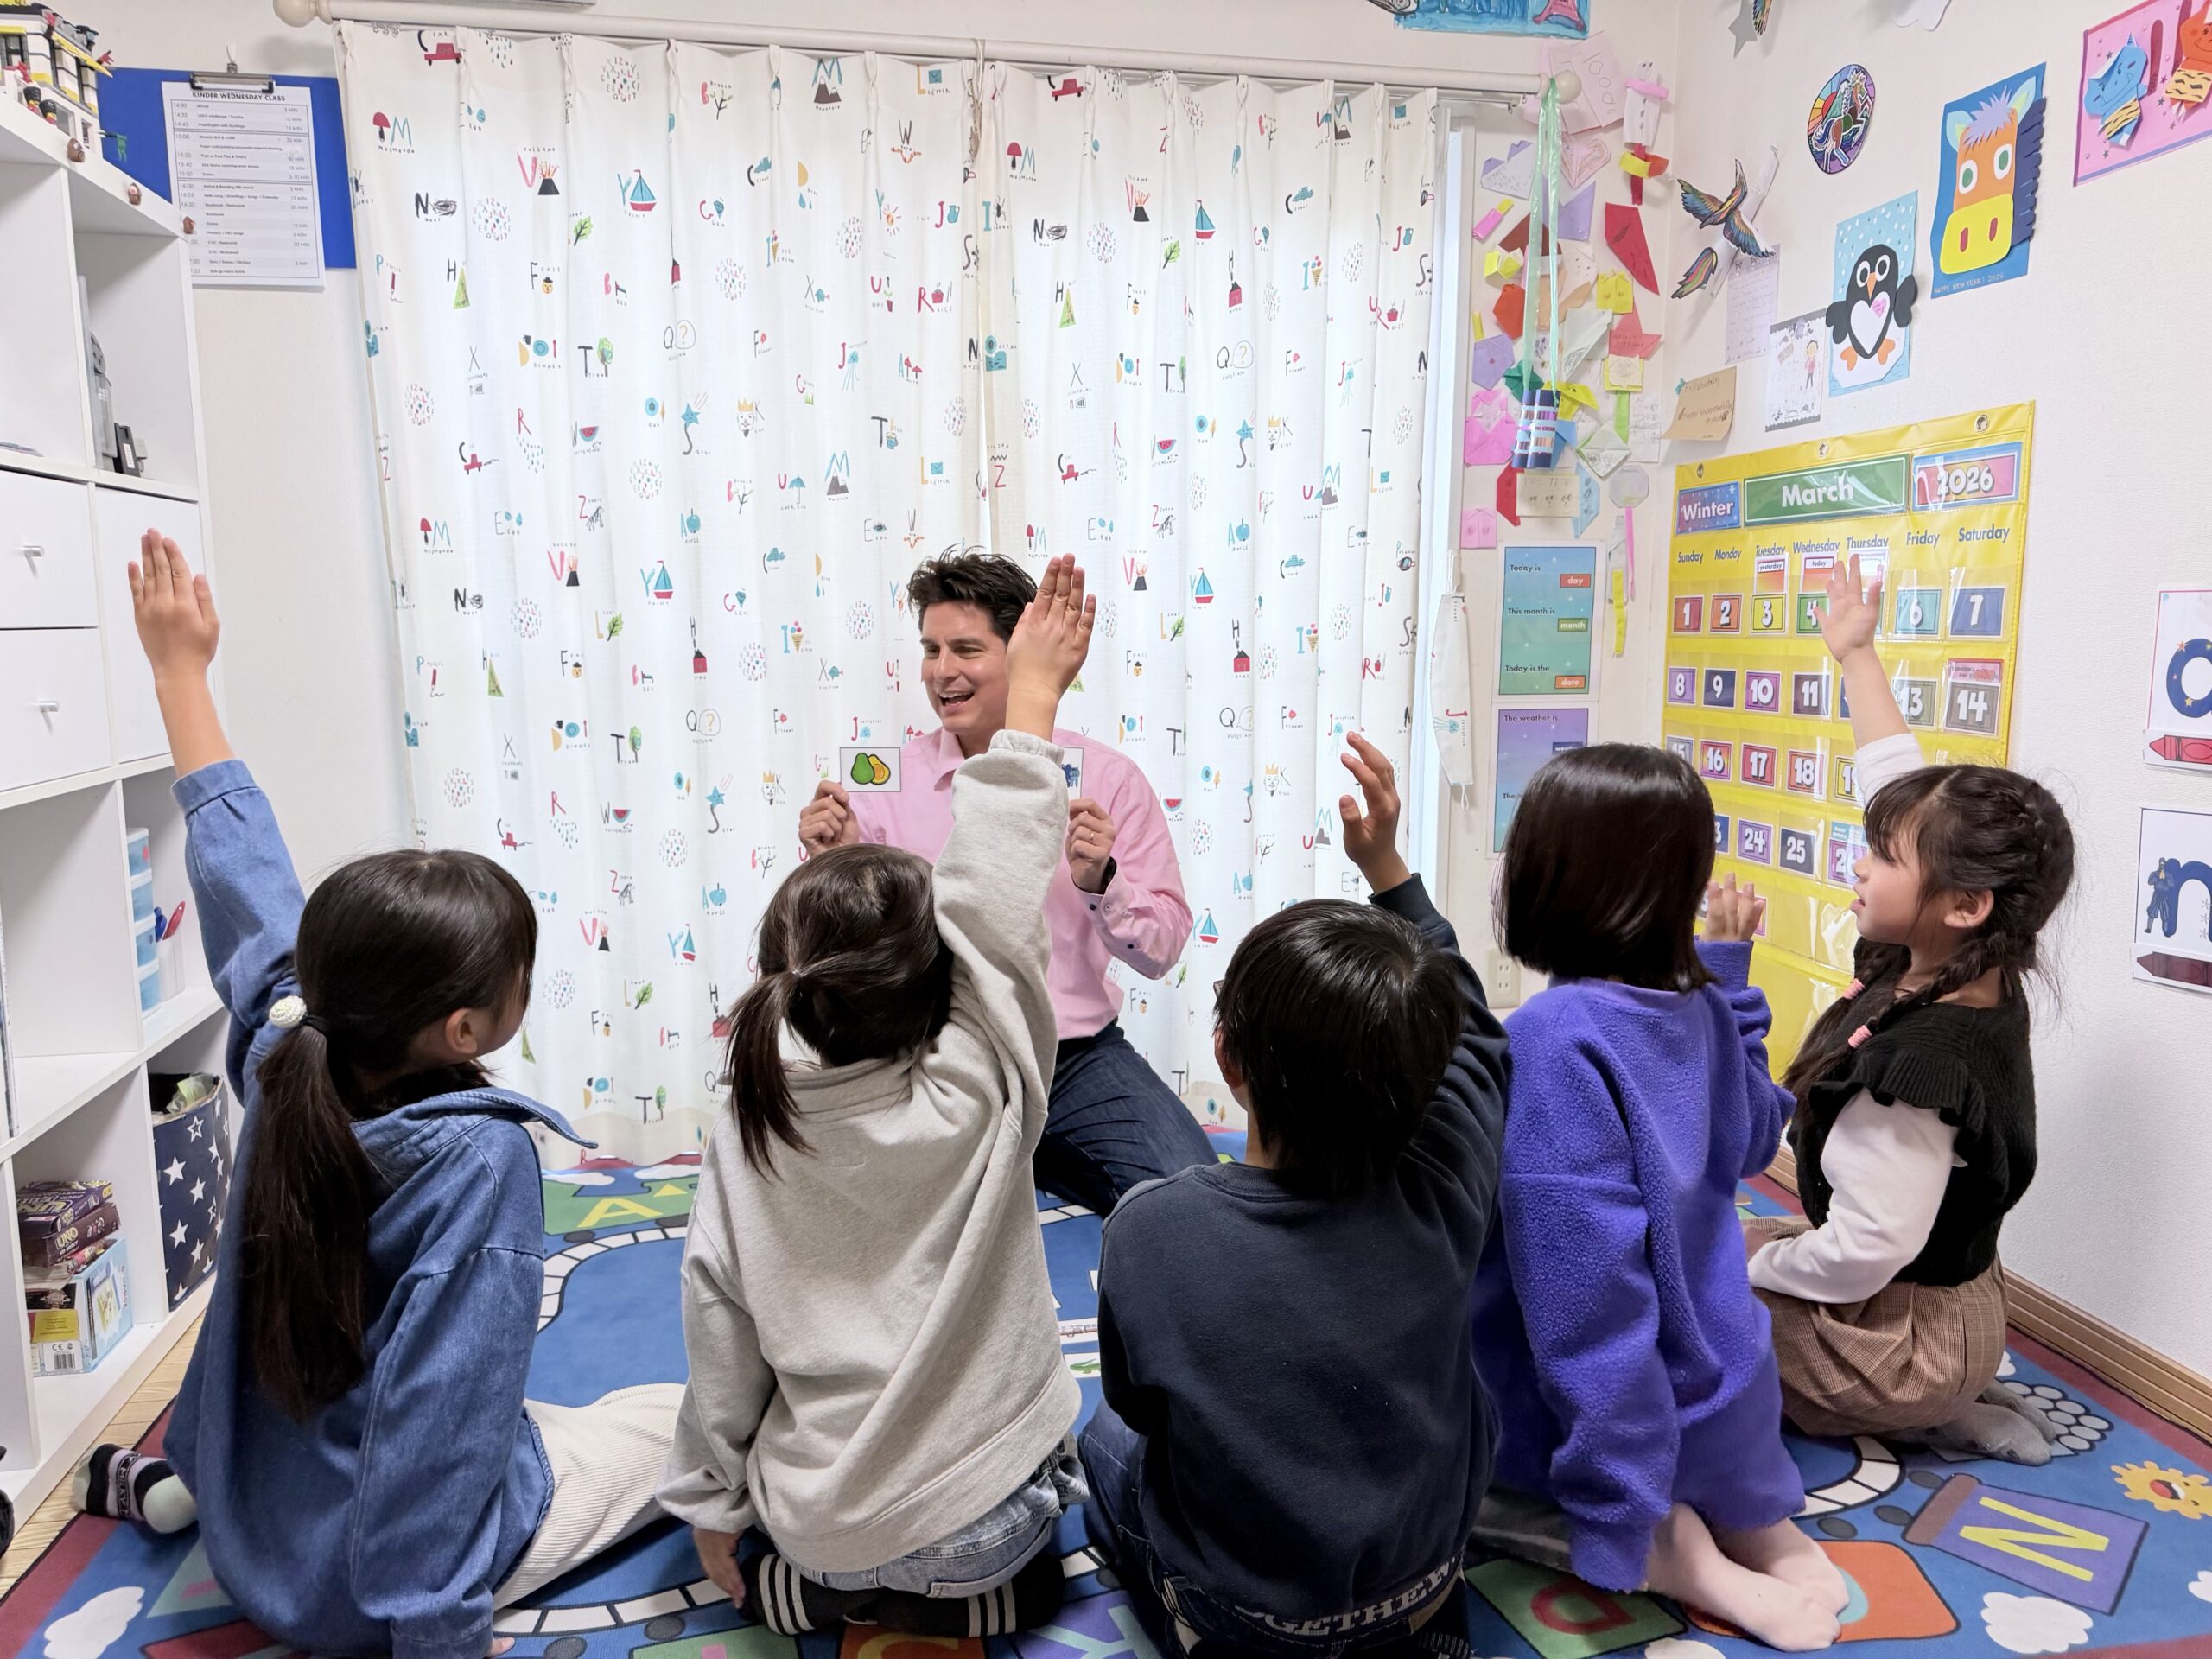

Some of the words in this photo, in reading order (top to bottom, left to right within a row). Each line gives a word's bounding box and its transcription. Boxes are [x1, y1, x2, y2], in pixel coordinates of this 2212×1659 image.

[220, 92, 263, 101] WEDNESDAY
[391, 116, 411, 147] M
[898, 119, 912, 145] W
[517, 151, 537, 188] V
[415, 192, 429, 219] N
[934, 200, 945, 228] J
[982, 200, 992, 232] I
[1033, 218, 1045, 243] N
[1392, 226, 1402, 251] J
[447, 258, 457, 282] H
[870, 276, 882, 293] U
[1055, 280, 1064, 303] H
[918, 286, 935, 313] R
[664, 326, 674, 350] Q
[577, 346, 594, 378] T
[838, 342, 847, 369] J
[1217, 346, 1230, 369] Q
[1160, 363, 1176, 393] T
[870, 416, 888, 448] T
[824, 450, 850, 482] M
[920, 456, 929, 485] L
[994, 464, 1007, 488] Z
[778, 474, 787, 490] U
[1303, 485, 1313, 500] U
[1782, 474, 1854, 507] March
[1936, 465, 1994, 496] 2026
[1682, 499, 1734, 521] Winter
[433, 520, 451, 547] M
[494, 512, 505, 535] E
[1678, 550, 1703, 565] Sunday
[1714, 546, 1742, 562] Monday
[1756, 543, 1786, 557] Tuesday
[1793, 538, 1840, 554] Wednesday
[1846, 534, 1889, 548] Thursday
[1906, 530, 1940, 549] Friday
[1958, 524, 2010, 543] Saturday
[1510, 564, 1533, 573] Today
[1567, 577, 1584, 586] day
[454, 588, 467, 612] N
[1720, 600, 1731, 626] 2
[1807, 599, 1817, 626] 4
[1910, 598, 1923, 626] 6
[1969, 594, 1984, 626] 7
[1683, 602, 1691, 626] 1
[1761, 601, 1773, 627] 3
[1362, 657, 1376, 680] R
[1675, 673, 1685, 696] 8
[1713, 675, 1723, 698] 9
[1751, 680, 1774, 704] 10
[1802, 681, 1819, 706] 11
[1219, 707, 1235, 728] Q
[1957, 690, 1988, 721] 14
[1707, 748, 1725, 772] 16
[1750, 752, 1767, 777] 17
[1795, 758, 1815, 785] 18
[1744, 828, 1765, 853] 24
[1786, 836, 1806, 863] 25
[635, 1097, 652, 1124] T
[577, 1198, 663, 1228] A
[54, 1226, 79, 1249] UNO
[1960, 1496, 2109, 1582] N
